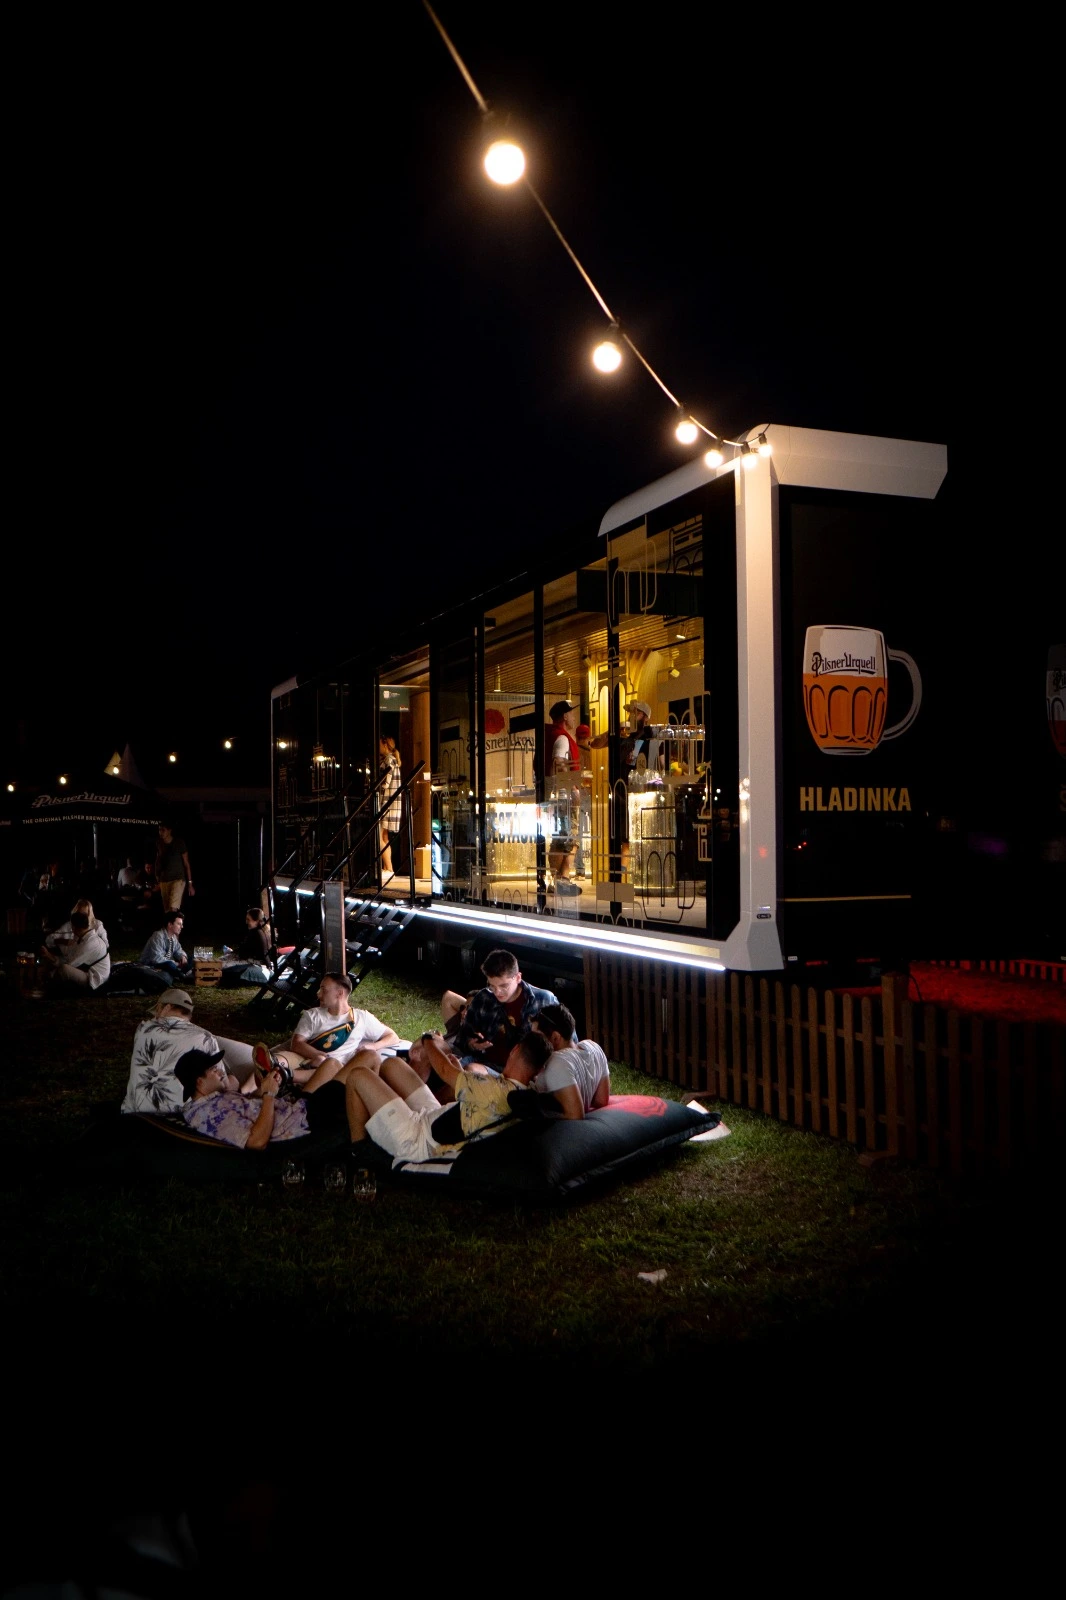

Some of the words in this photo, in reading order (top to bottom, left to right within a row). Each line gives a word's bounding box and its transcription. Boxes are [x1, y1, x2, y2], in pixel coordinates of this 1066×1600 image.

[811, 652, 845, 678] Pilsner
[843, 652, 876, 675] Urquell
[31, 794, 84, 808] Pilsner
[83, 791, 132, 805] Urquell
[799, 786, 912, 811] HLADINKA
[34, 816, 62, 824] ORIGINAL
